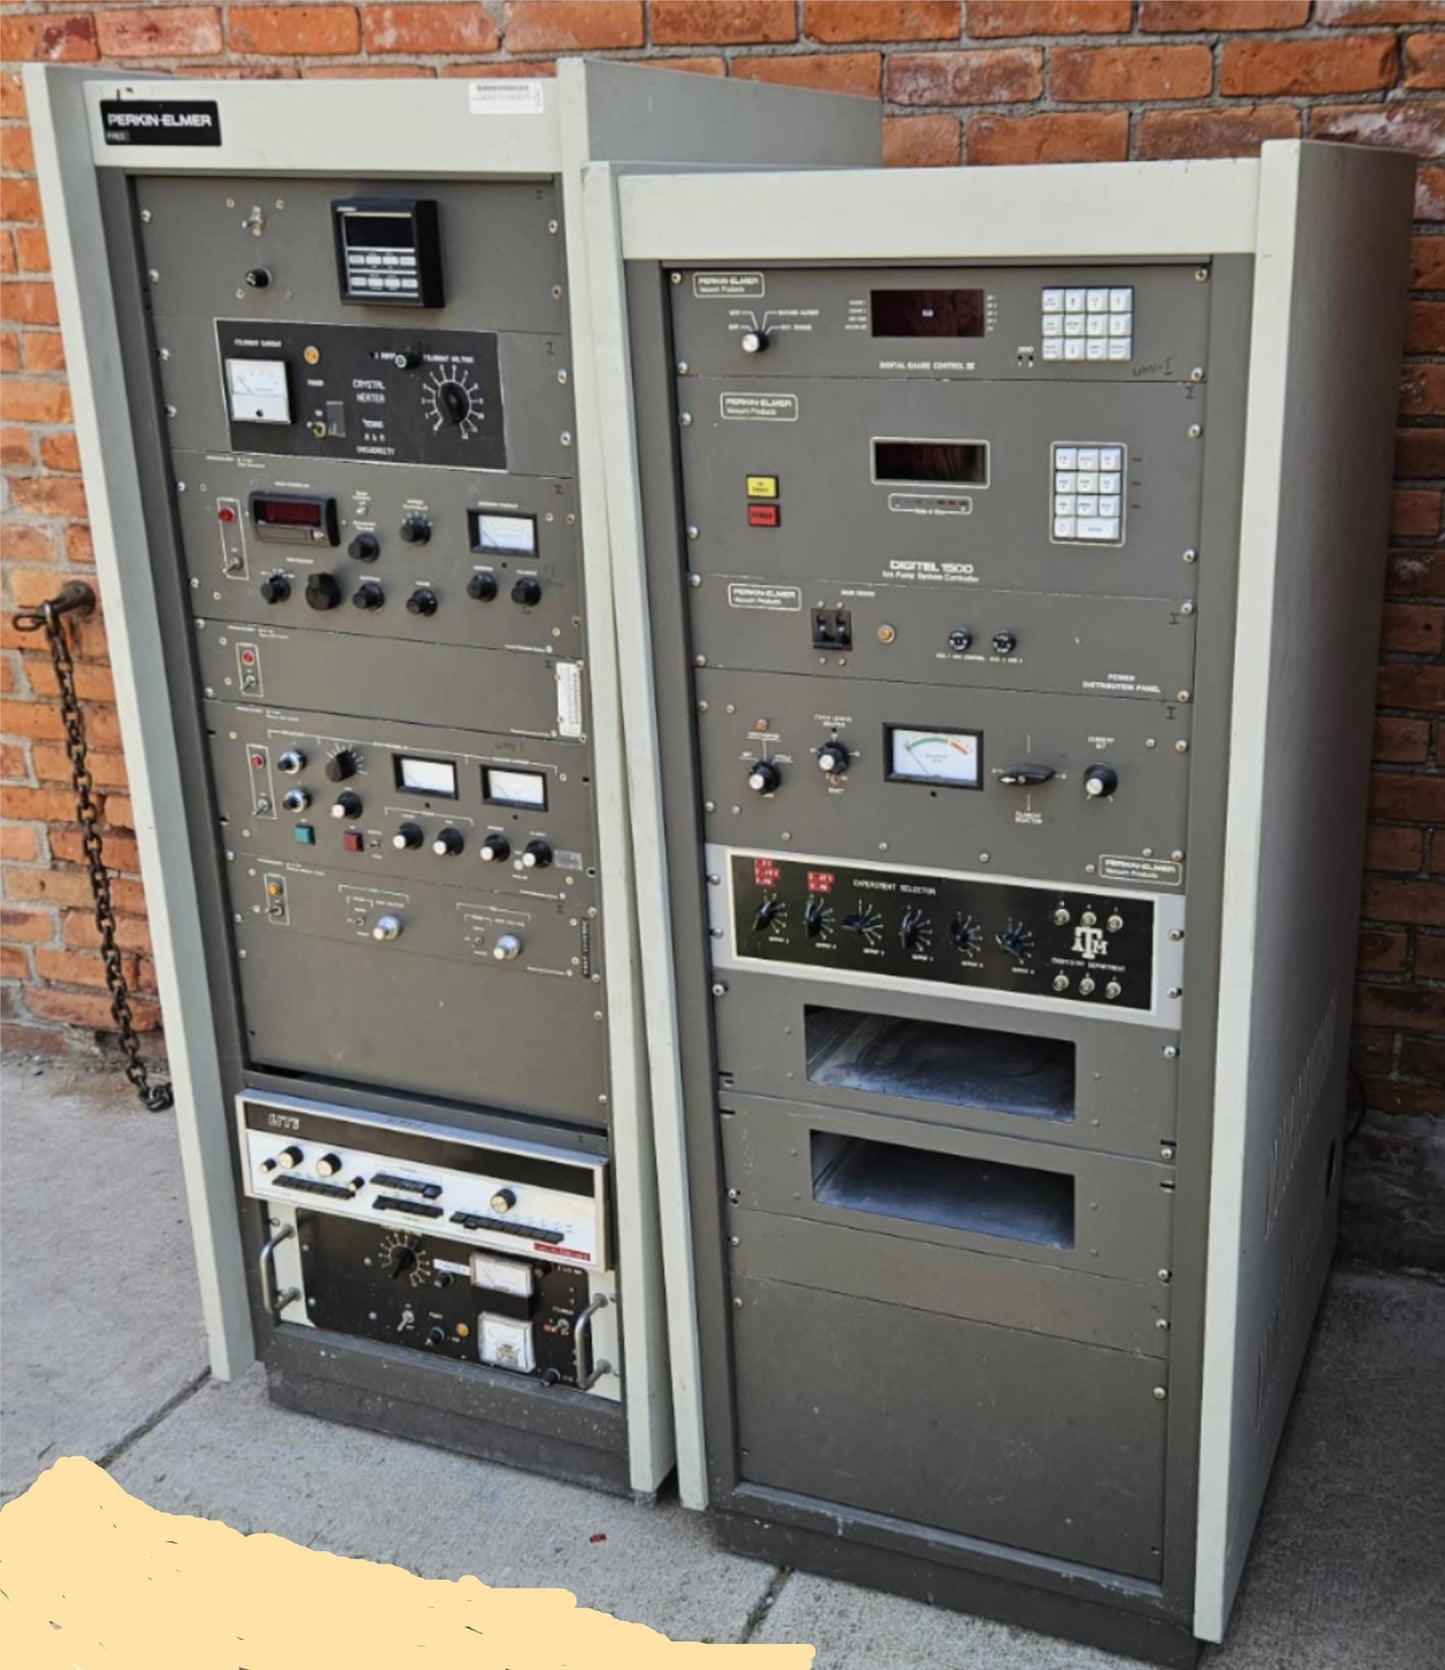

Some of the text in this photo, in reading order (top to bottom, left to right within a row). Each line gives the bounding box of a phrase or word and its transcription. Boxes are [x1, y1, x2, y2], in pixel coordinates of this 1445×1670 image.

[107, 113, 213, 128] PERKIN-ELMER
[352, 379, 386, 390] CRYSTAL
[356, 392, 386, 404] HEATER
[725, 398, 792, 407] PERKIN-ELMER
[890, 560, 974, 574] DIGITEL 1500
[895, 571, 916, 581] Pump
[917, 572, 944, 581] System
[944, 573, 980, 583] Controller
[733, 588, 796, 599] PERKIN-ELMER
[1107, 673, 1136, 682] POWER
[1082, 681, 1161, 694] DISTRIBUTION PANEL
[1105, 859, 1176, 873] PERKIN-ELMER
[1130, 869, 1159, 879] Products
[853, 879, 937, 896] EXPERIMENT SELECTOR
